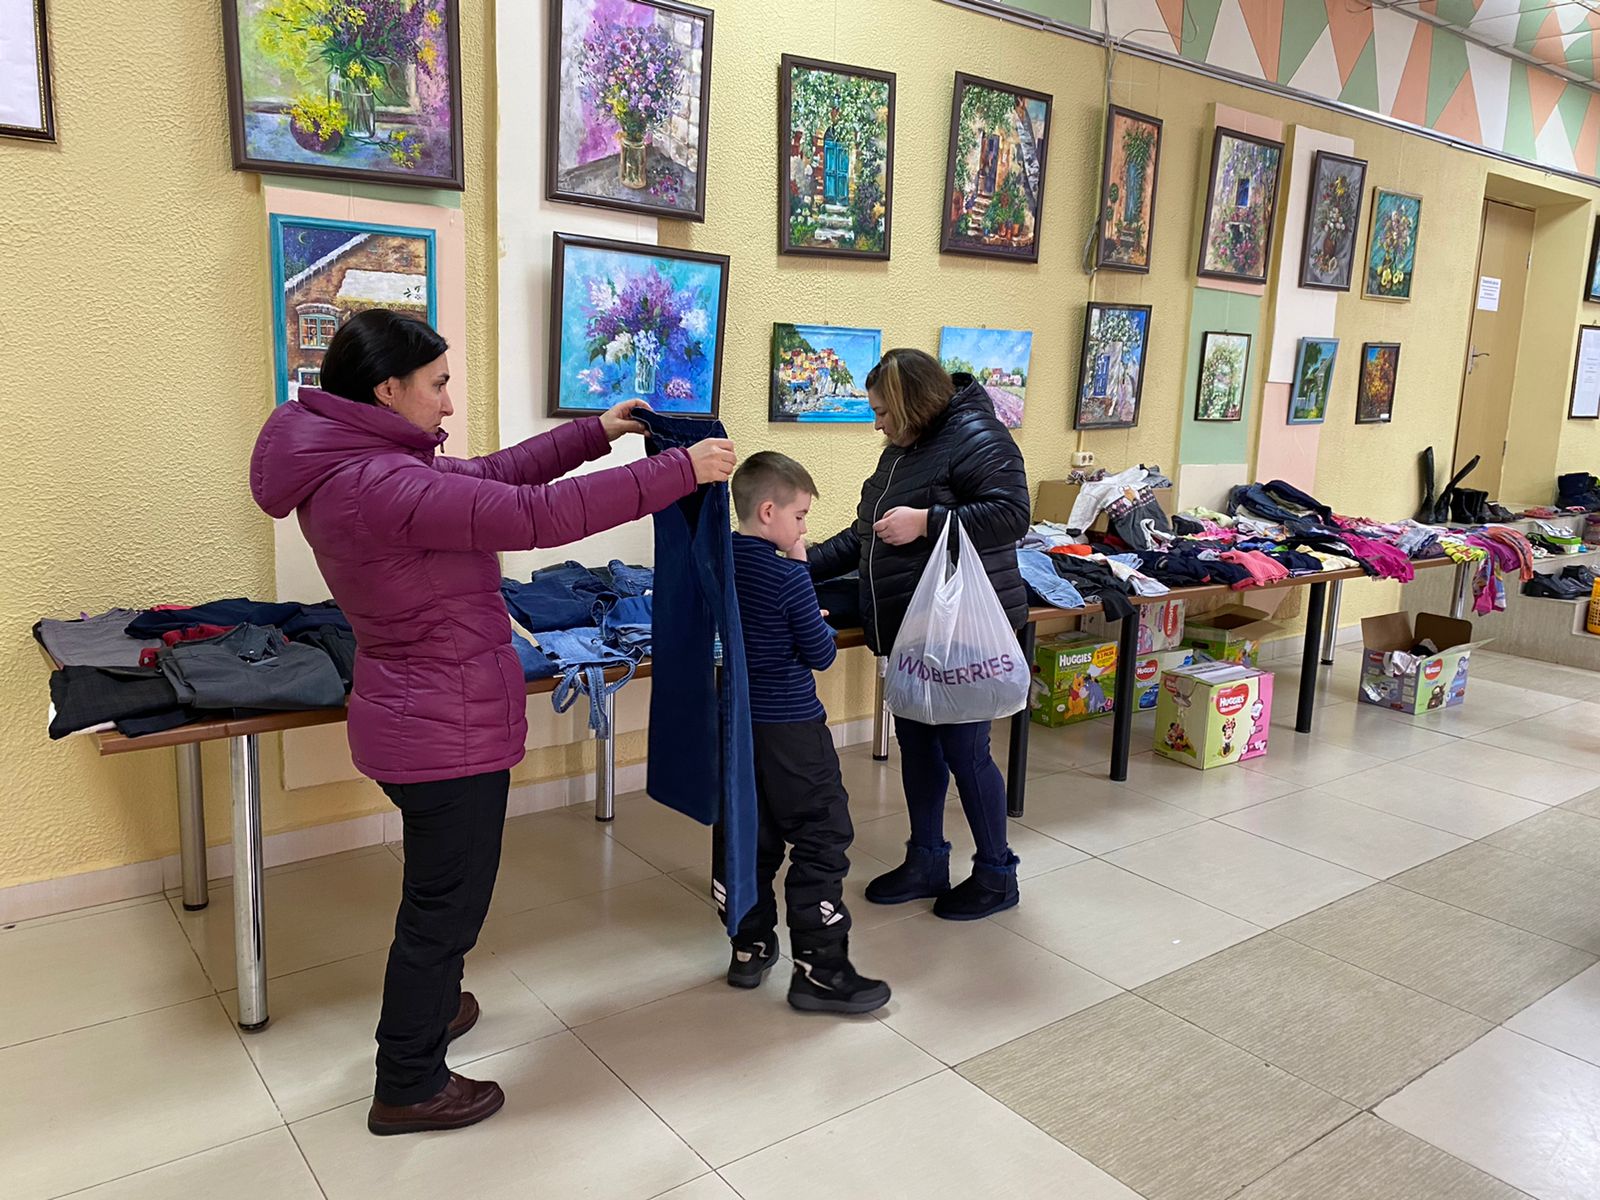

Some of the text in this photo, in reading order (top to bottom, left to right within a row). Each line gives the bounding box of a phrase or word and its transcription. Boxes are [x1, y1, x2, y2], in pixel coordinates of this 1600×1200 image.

[1059, 652, 1092, 667] HUGGIES
[898, 653, 1015, 686] WIDBERRIES
[1219, 694, 1245, 708] HUGGIES
